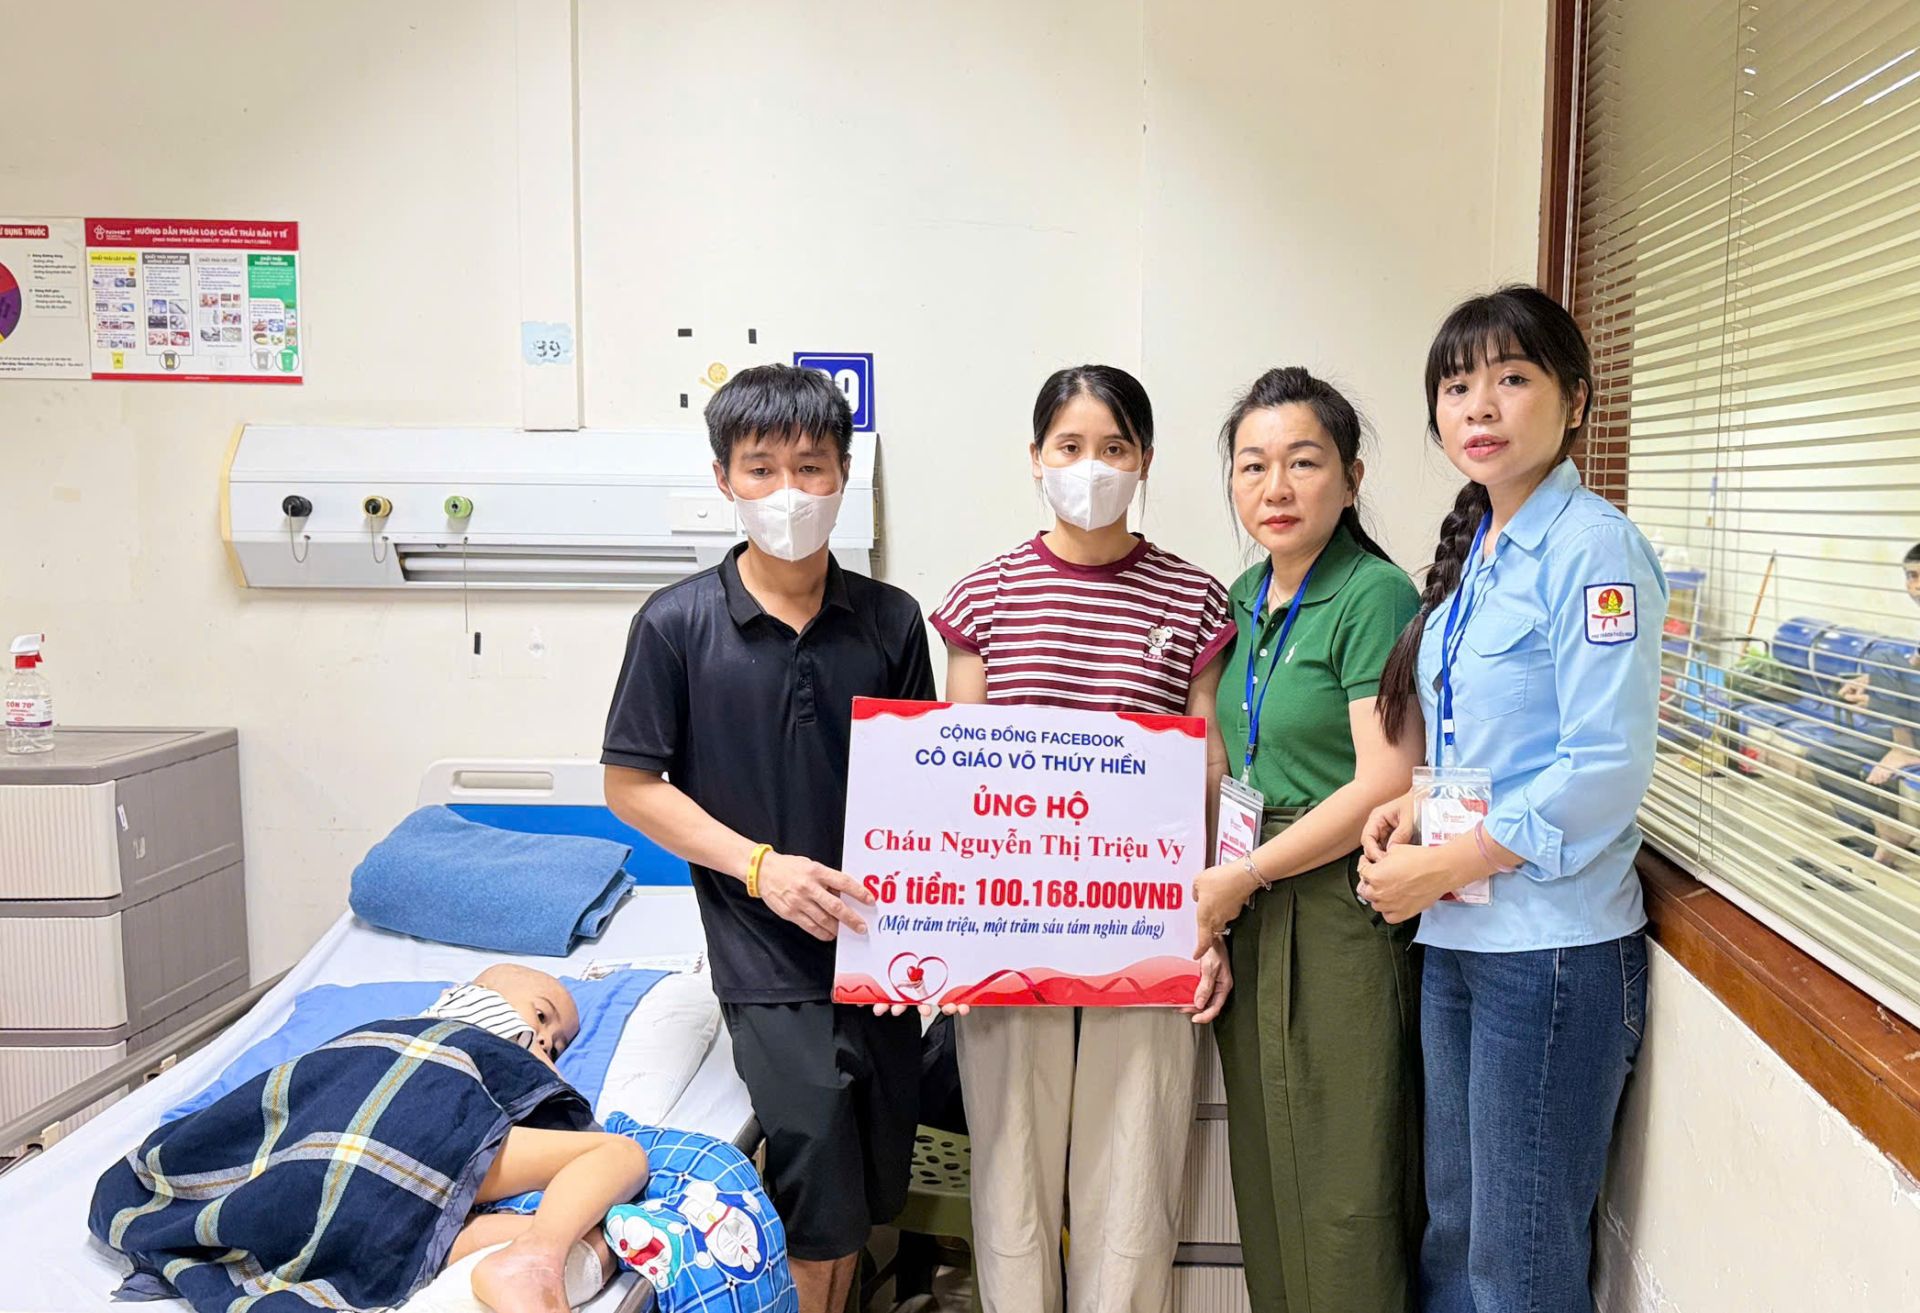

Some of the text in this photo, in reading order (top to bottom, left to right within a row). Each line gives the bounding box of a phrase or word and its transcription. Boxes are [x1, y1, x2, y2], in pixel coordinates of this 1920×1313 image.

[134, 226, 161, 235] HƯỚNG
[162, 225, 178, 235] DẪN
[179, 226, 199, 236] PHÂN
[200, 228, 217, 237] LOẠI
[219, 227, 238, 237] CHẤT
[239, 228, 255, 237] THẢI
[272, 230, 279, 238] Y
[279, 228, 288, 238] TẾ
[940, 724, 1125, 748] CỘNG ĐỒNG FACEBOOK
[915, 746, 1146, 775] CÔ GIÁO VÕ THÚY HIỀN
[973, 784, 1090, 826] ỦNG HỘ
[864, 828, 1185, 865] Cháu Nguyễn Thị Triệu Vy
[863, 871, 1183, 910] Số tiền: 100.168.000VNĐ
[878, 914, 1166, 941] (Một trăm triệu, một trăm sáu tám nghìn đồng)
